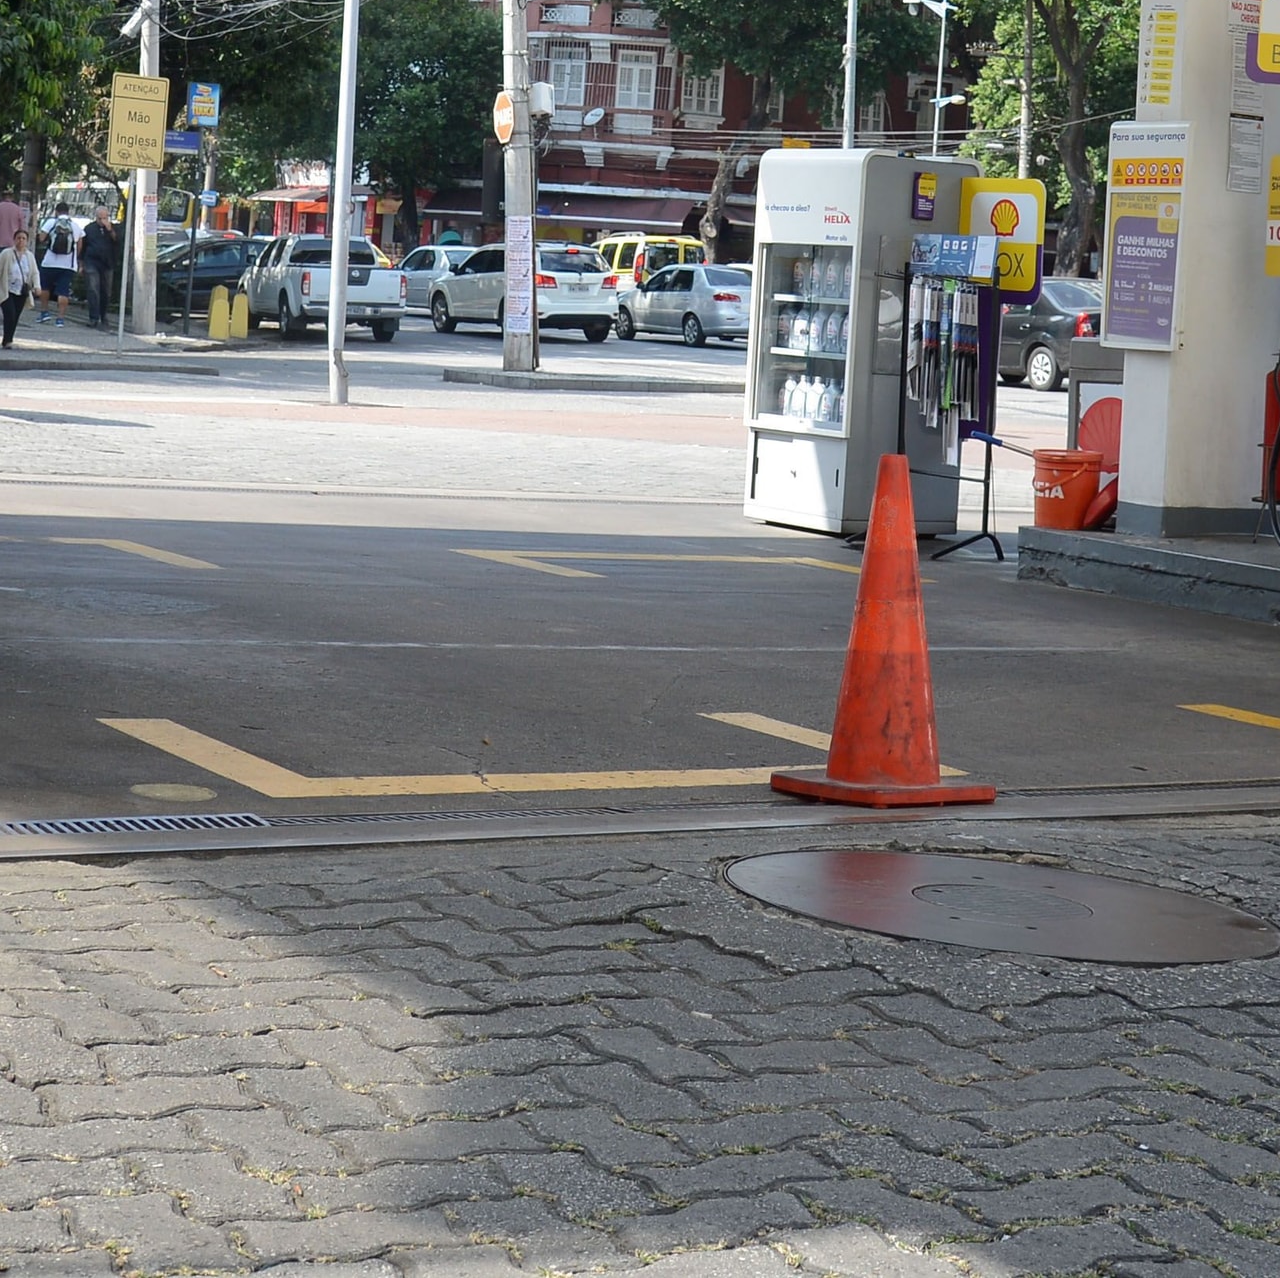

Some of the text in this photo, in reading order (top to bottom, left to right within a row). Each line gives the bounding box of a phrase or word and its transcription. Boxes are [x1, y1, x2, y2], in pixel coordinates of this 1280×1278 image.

[123, 83, 159, 95] ATENÇÃO
[128, 110, 150, 124] Mão
[116, 133, 157, 148] Inglesa
[1112, 133, 1129, 141] Para
[1147, 133, 1185, 143] segurança
[771, 204, 789, 212] checou
[824, 215, 851, 224] HELIX
[1118, 235, 1175, 248] GANHE MILHAS
[1117, 246, 1167, 258] E DESCONTOS
[996, 253, 1024, 277] OX
